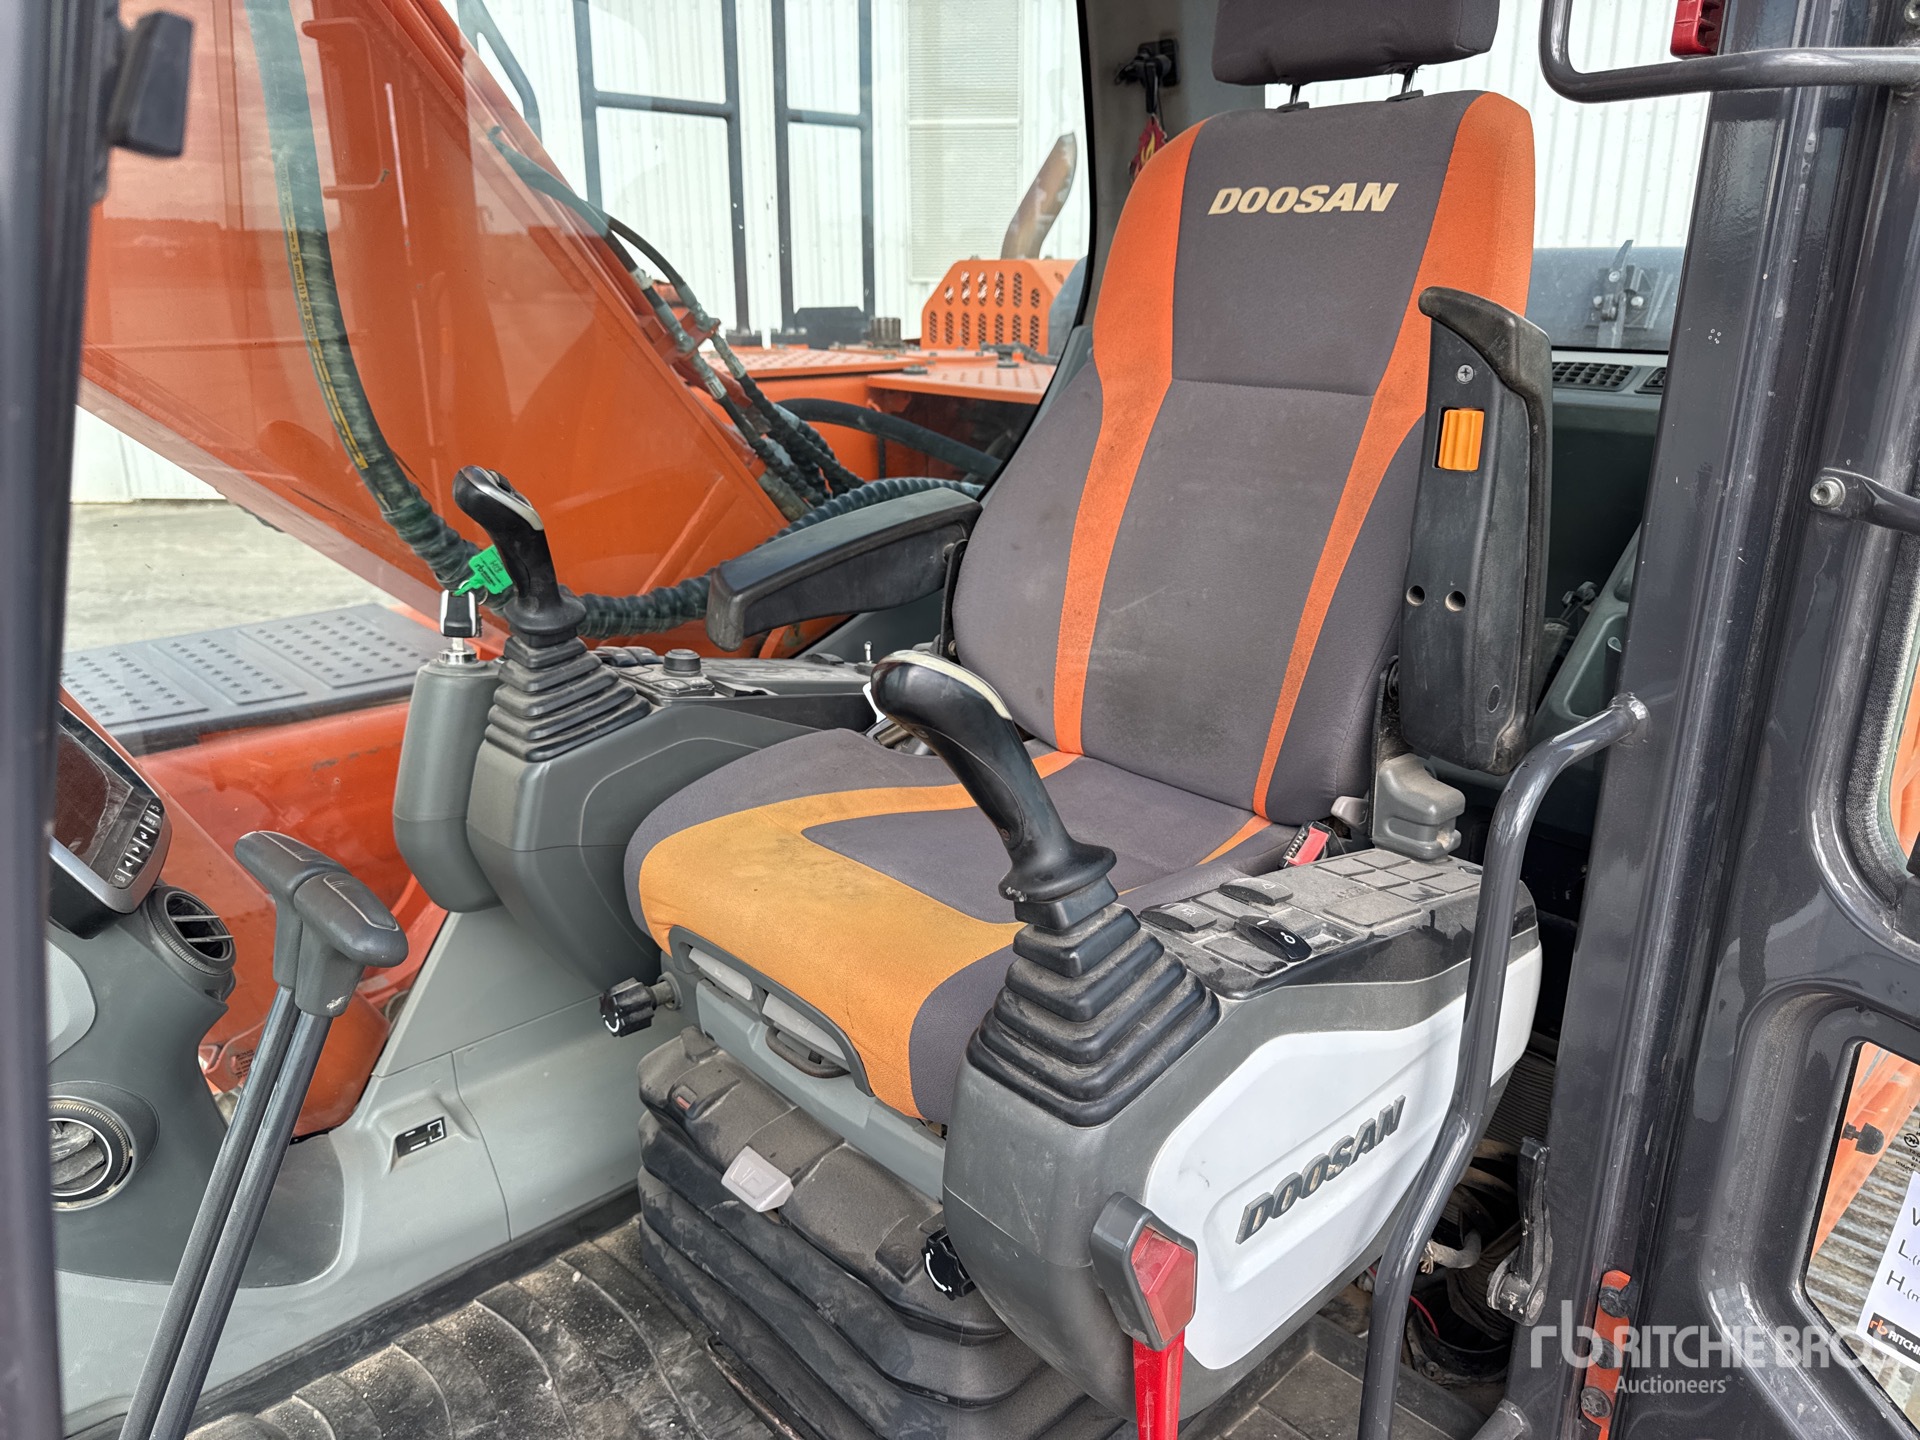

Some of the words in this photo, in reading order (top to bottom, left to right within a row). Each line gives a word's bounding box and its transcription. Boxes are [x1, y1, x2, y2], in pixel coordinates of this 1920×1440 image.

[1208, 183, 1399, 215] DOOSAN
[1235, 1094, 1406, 1245] DOOSAN
[1887, 1330, 1920, 1357] RITCHI
